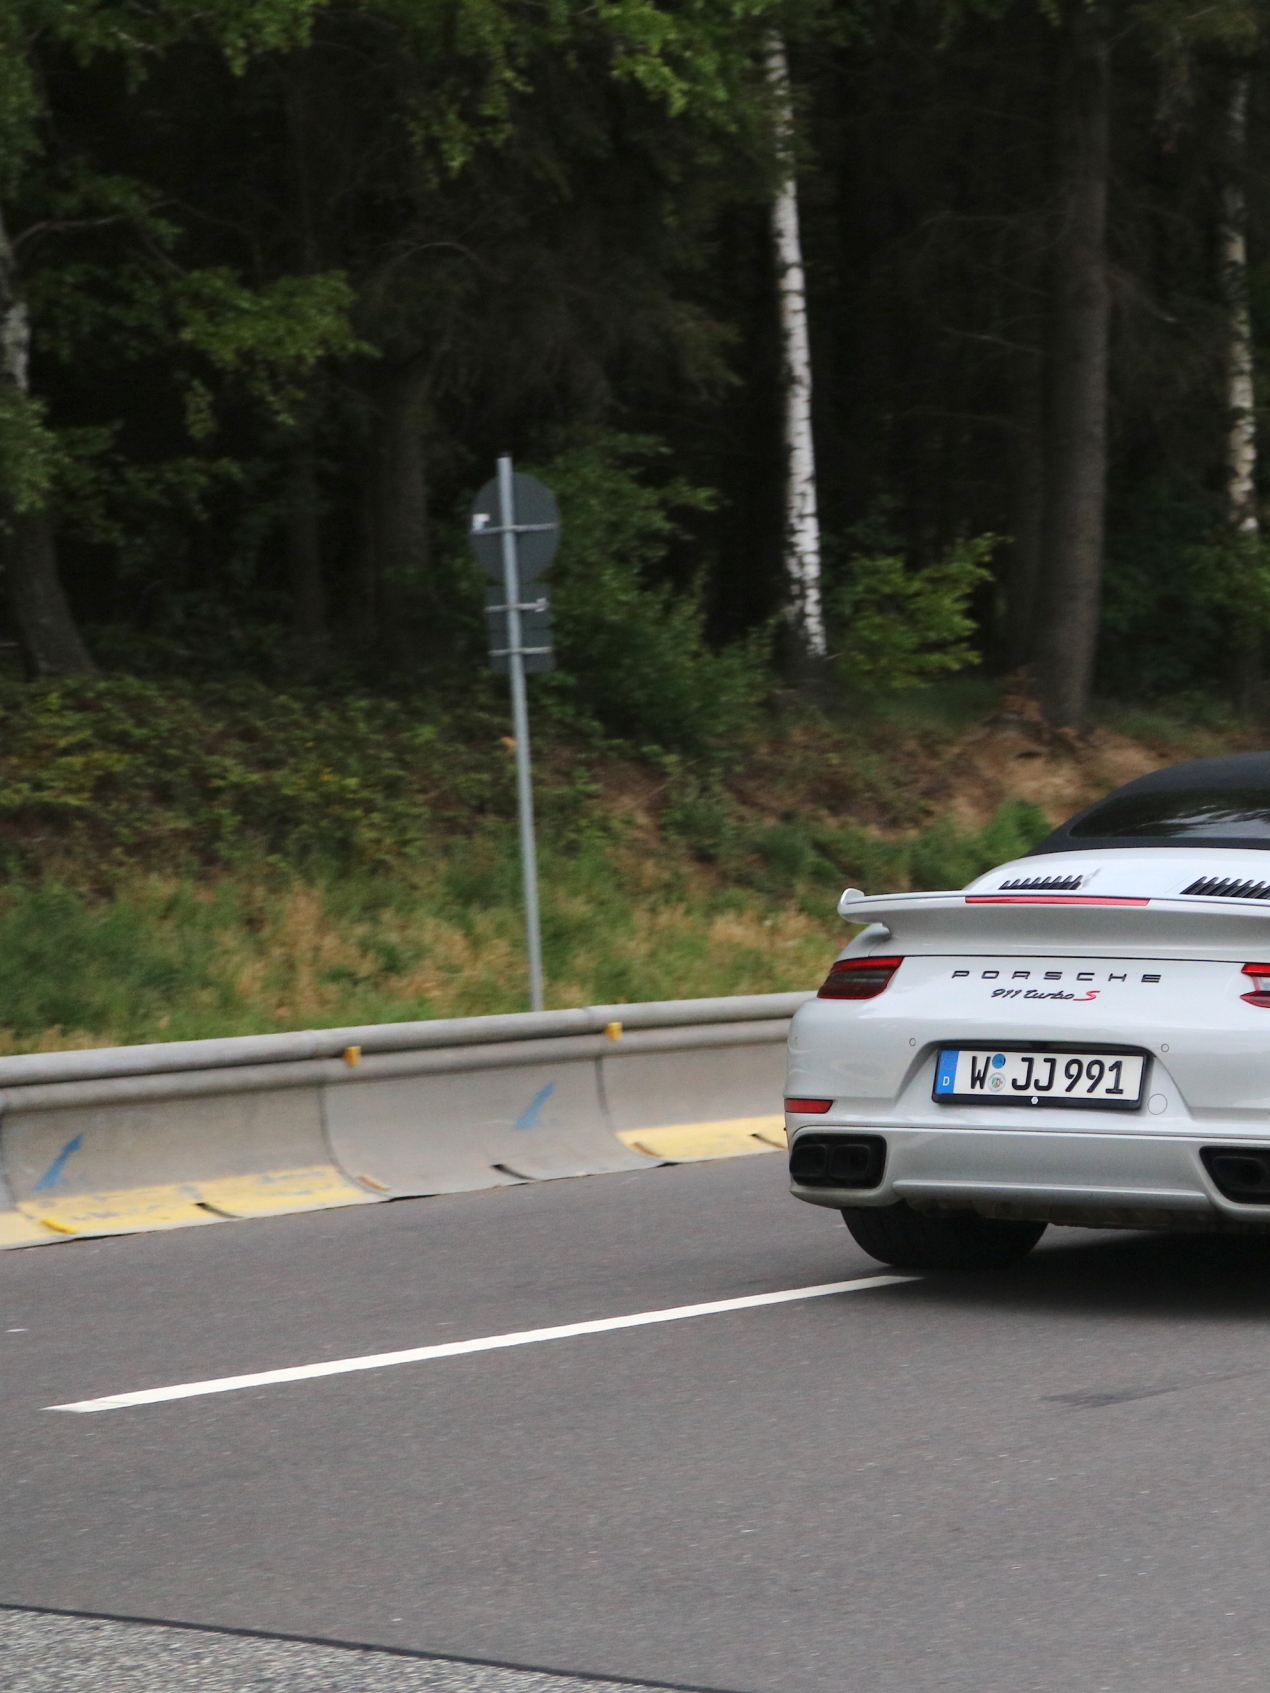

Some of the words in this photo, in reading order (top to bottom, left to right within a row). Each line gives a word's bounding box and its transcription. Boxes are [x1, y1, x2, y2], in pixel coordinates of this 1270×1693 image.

[951, 970, 1162, 983] PORSCHE
[991, 988, 1023, 998] 911
[1023, 989, 1075, 999] turbo
[1073, 990, 1101, 1001] S
[942, 1076, 950, 1086] D
[970, 1055, 991, 1089] W
[1011, 1057, 1057, 1091] JJ
[1064, 1058, 1125, 1094] 991
